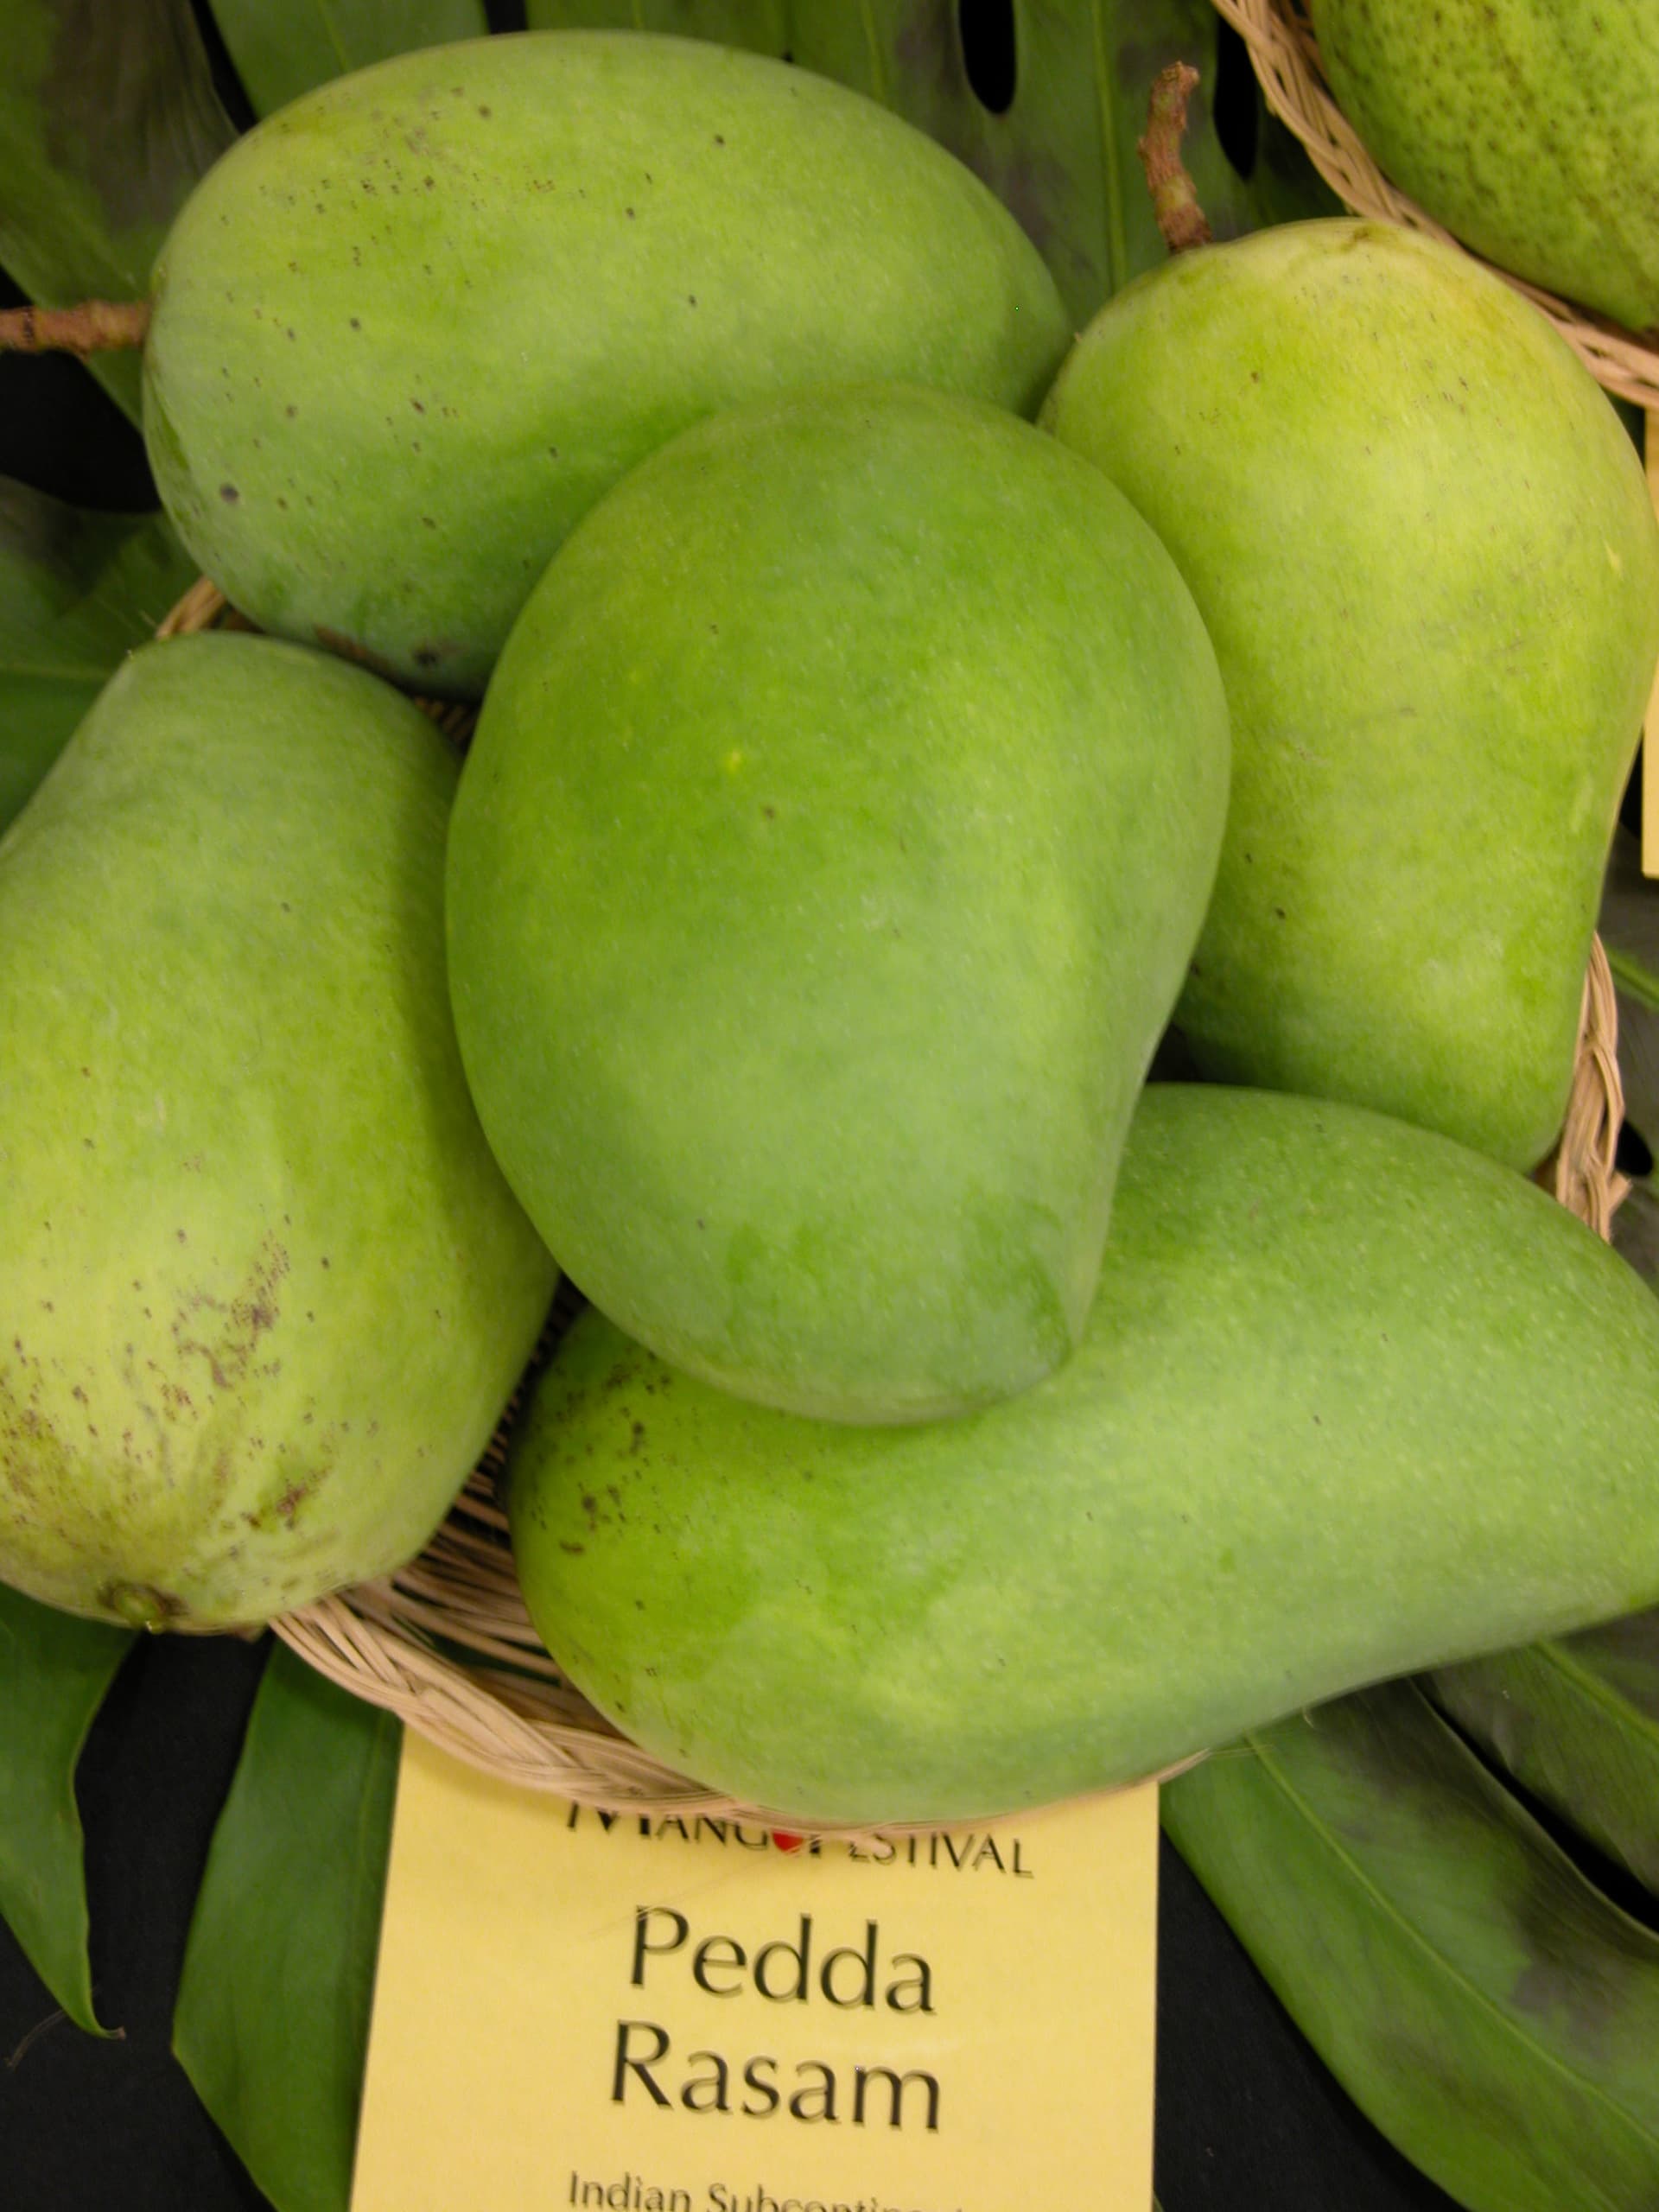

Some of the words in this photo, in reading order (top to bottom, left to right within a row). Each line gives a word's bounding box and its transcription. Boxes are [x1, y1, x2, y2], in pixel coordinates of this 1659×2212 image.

[631, 1904, 936, 2015] Pedda
[611, 2018, 939, 2134] Rasam
[569, 2170, 691, 2212] Indian
